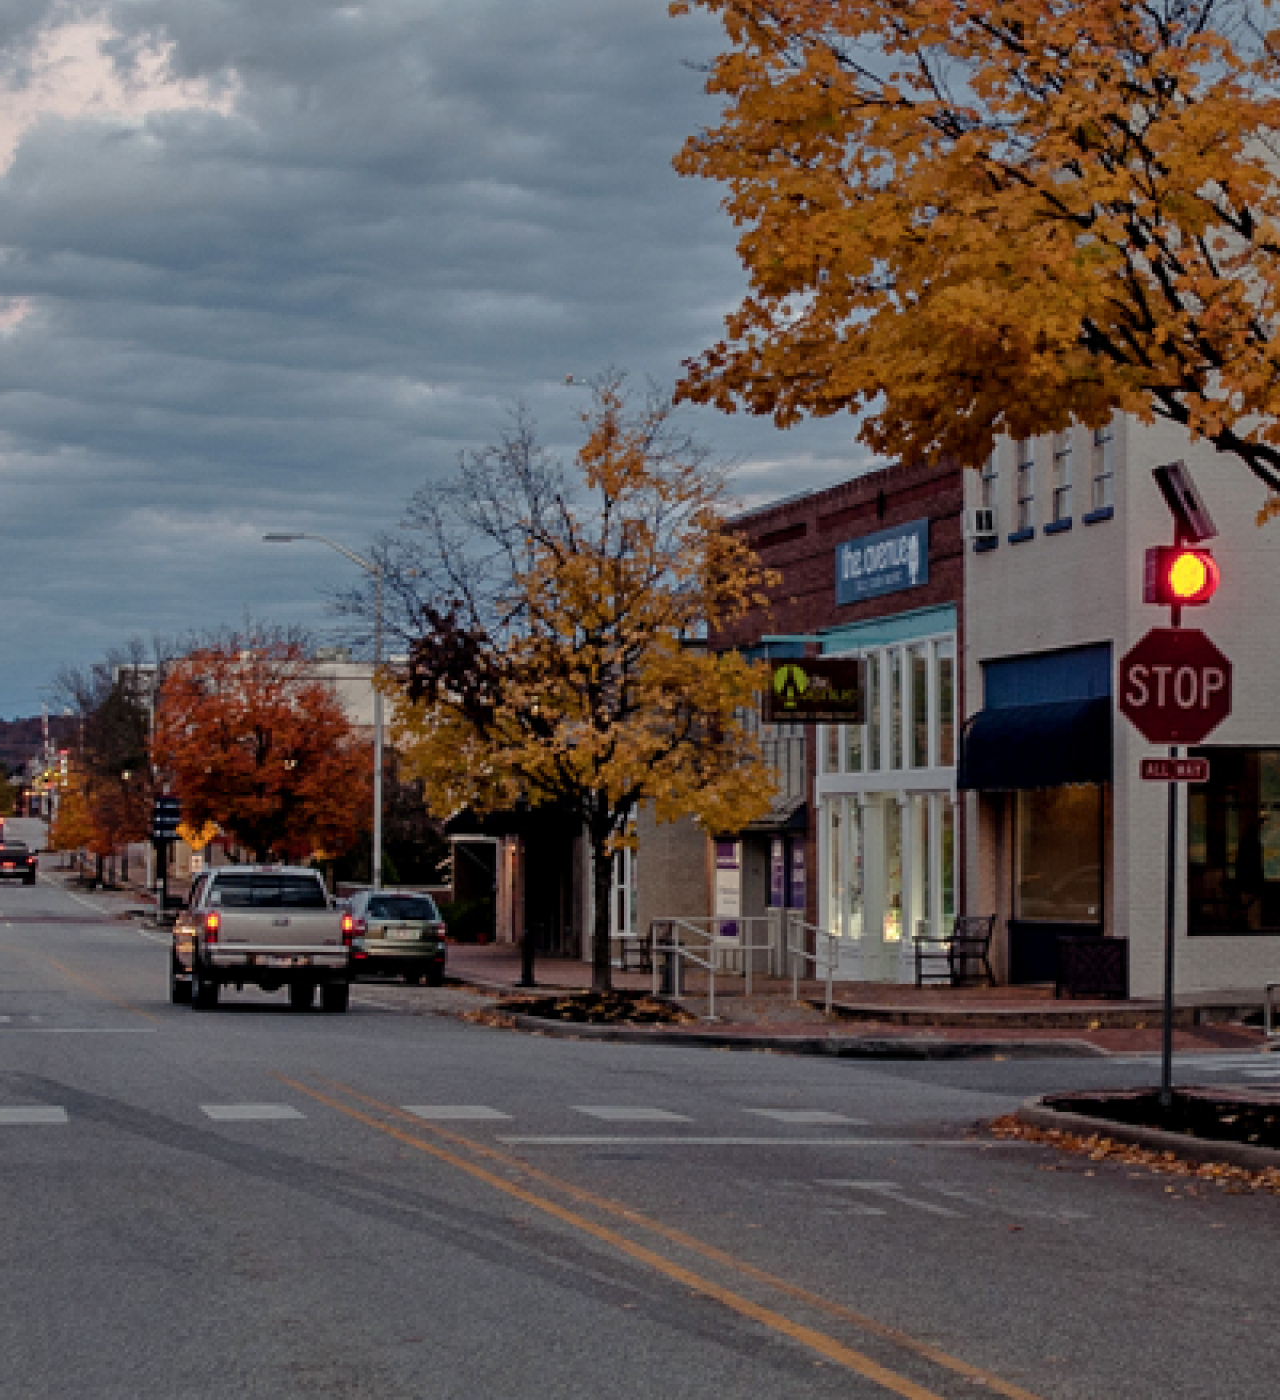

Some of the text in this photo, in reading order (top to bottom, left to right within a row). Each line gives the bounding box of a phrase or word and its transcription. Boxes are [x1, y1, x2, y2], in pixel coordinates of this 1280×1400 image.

[1125, 664, 1225, 709] STOP
[1144, 762, 1201, 777] ALL WAY
